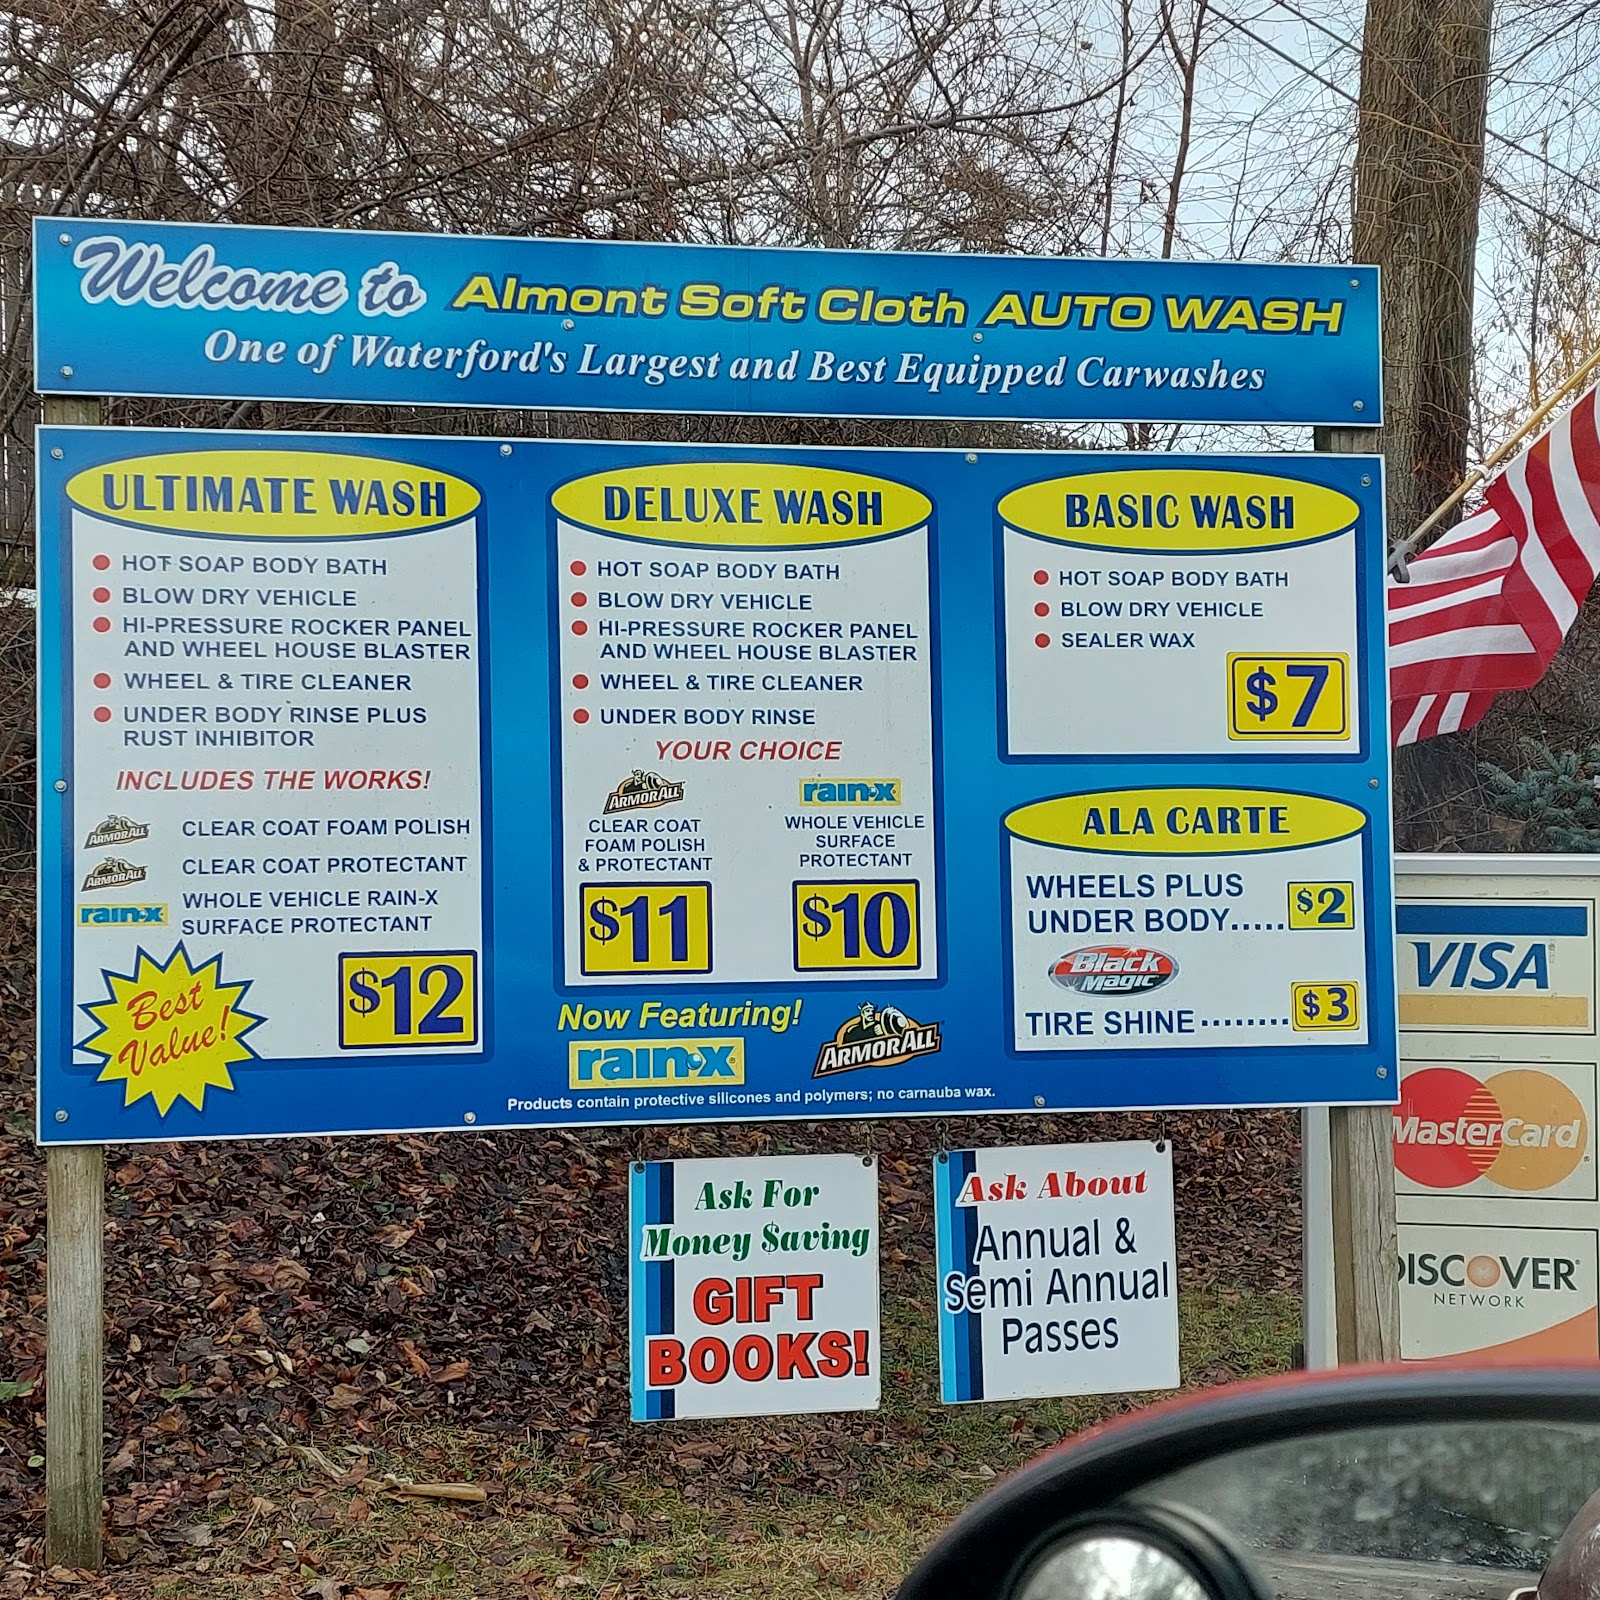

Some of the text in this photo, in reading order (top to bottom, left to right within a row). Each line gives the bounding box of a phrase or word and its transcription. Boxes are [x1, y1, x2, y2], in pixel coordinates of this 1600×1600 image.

[73, 236, 1346, 333] Welcome to Almont Soft Cloth AUTO WASH
[205, 329, 1265, 394] One of Waterford's Largest and Best Equipped Carwashes
[103, 474, 446, 516] ULTIMATE WASH
[604, 486, 882, 525] DELUXE WASH
[1066, 495, 1293, 529] BASIC WASH
[123, 555, 386, 575] HOT SOAP BODY BATH
[598, 562, 839, 579] HOT SOAP BODY BATH
[1060, 571, 1287, 586] HOT SOAP BODY BATH
[123, 588, 356, 606] BLOW DRY VEHICLE
[599, 593, 812, 610] BLOW DRY VEHICLE
[1062, 602, 1263, 616] BLOW DRY VEHICLE
[124, 617, 471, 636] HI-PRESSURE ROCKER PANEL
[599, 621, 918, 638] HI-PRESSURE ROCKER PANEL
[1062, 633, 1195, 647] SEALER WAX
[124, 641, 470, 659] AND WHEEL HOUSE BLASTER
[600, 644, 917, 660] AND WHEEL HOUSE BLASTER
[124, 673, 411, 690] WHEEL & TIRE CLEANER
[601, 674, 863, 690] WHEEL & TIRE CLEANER
[124, 707, 426, 723] UNDER BODY RINSE PLUS
[601, 709, 815, 724] UNDER BODY RINSE
[125, 730, 314, 746] RUST INHIBITOR
[657, 741, 842, 760] YOUR CHOICE
[117, 771, 431, 790] INCLUDES THE WORKS!
[183, 819, 469, 836] CLEAR COAT FOAM POLISH
[589, 820, 701, 832] CLEAR COAT
[785, 816, 924, 829] WHOLE VEHICLE
[1084, 807, 1290, 834] ALA CARTE
[586, 839, 704, 852] FOAM POLISH
[816, 835, 895, 848] SURFACE
[183, 857, 467, 874] CLEAR COAT PROTECTANT
[579, 858, 712, 871] & PROTECTANT
[800, 854, 912, 867] PROTECTANT
[1026, 874, 1243, 898] WHEELS PLUS
[183, 890, 438, 908] WHOLE VEHICLE RAIN-X
[182, 916, 432, 935] SURFACE PROTECTANT
[589, 895, 689, 962] $11
[802, 891, 911, 959] $10
[1029, 909, 1134, 933] UNDER
[1069, 951, 1163, 972] Black
[1408, 941, 1549, 990] VISA
[1080, 974, 1159, 991] Magic
[126, 981, 205, 1030] Best
[349, 964, 465, 1037] $12
[557, 998, 803, 1033] Now Featuring!
[1026, 1011, 1094, 1035] TIRE
[118, 1005, 232, 1078] Value!
[507, 1085, 996, 1112] Products contain protective silicones and polymers; no carnauba wax.
[1393, 1116, 1581, 1148] MasterCard
[695, 1179, 820, 1211] Ask For
[960, 1170, 1149, 1203] Ask About
[643, 1225, 752, 1262] Money
[975, 1217, 1136, 1262] Annual &
[946, 1263, 1169, 1311] Semi Annual
[693, 1275, 823, 1325] GIFT
[1434, 1293, 1524, 1308] NETWORK
[1003, 1317, 1119, 1354] Passes
[648, 1331, 869, 1386] BOOKS!
